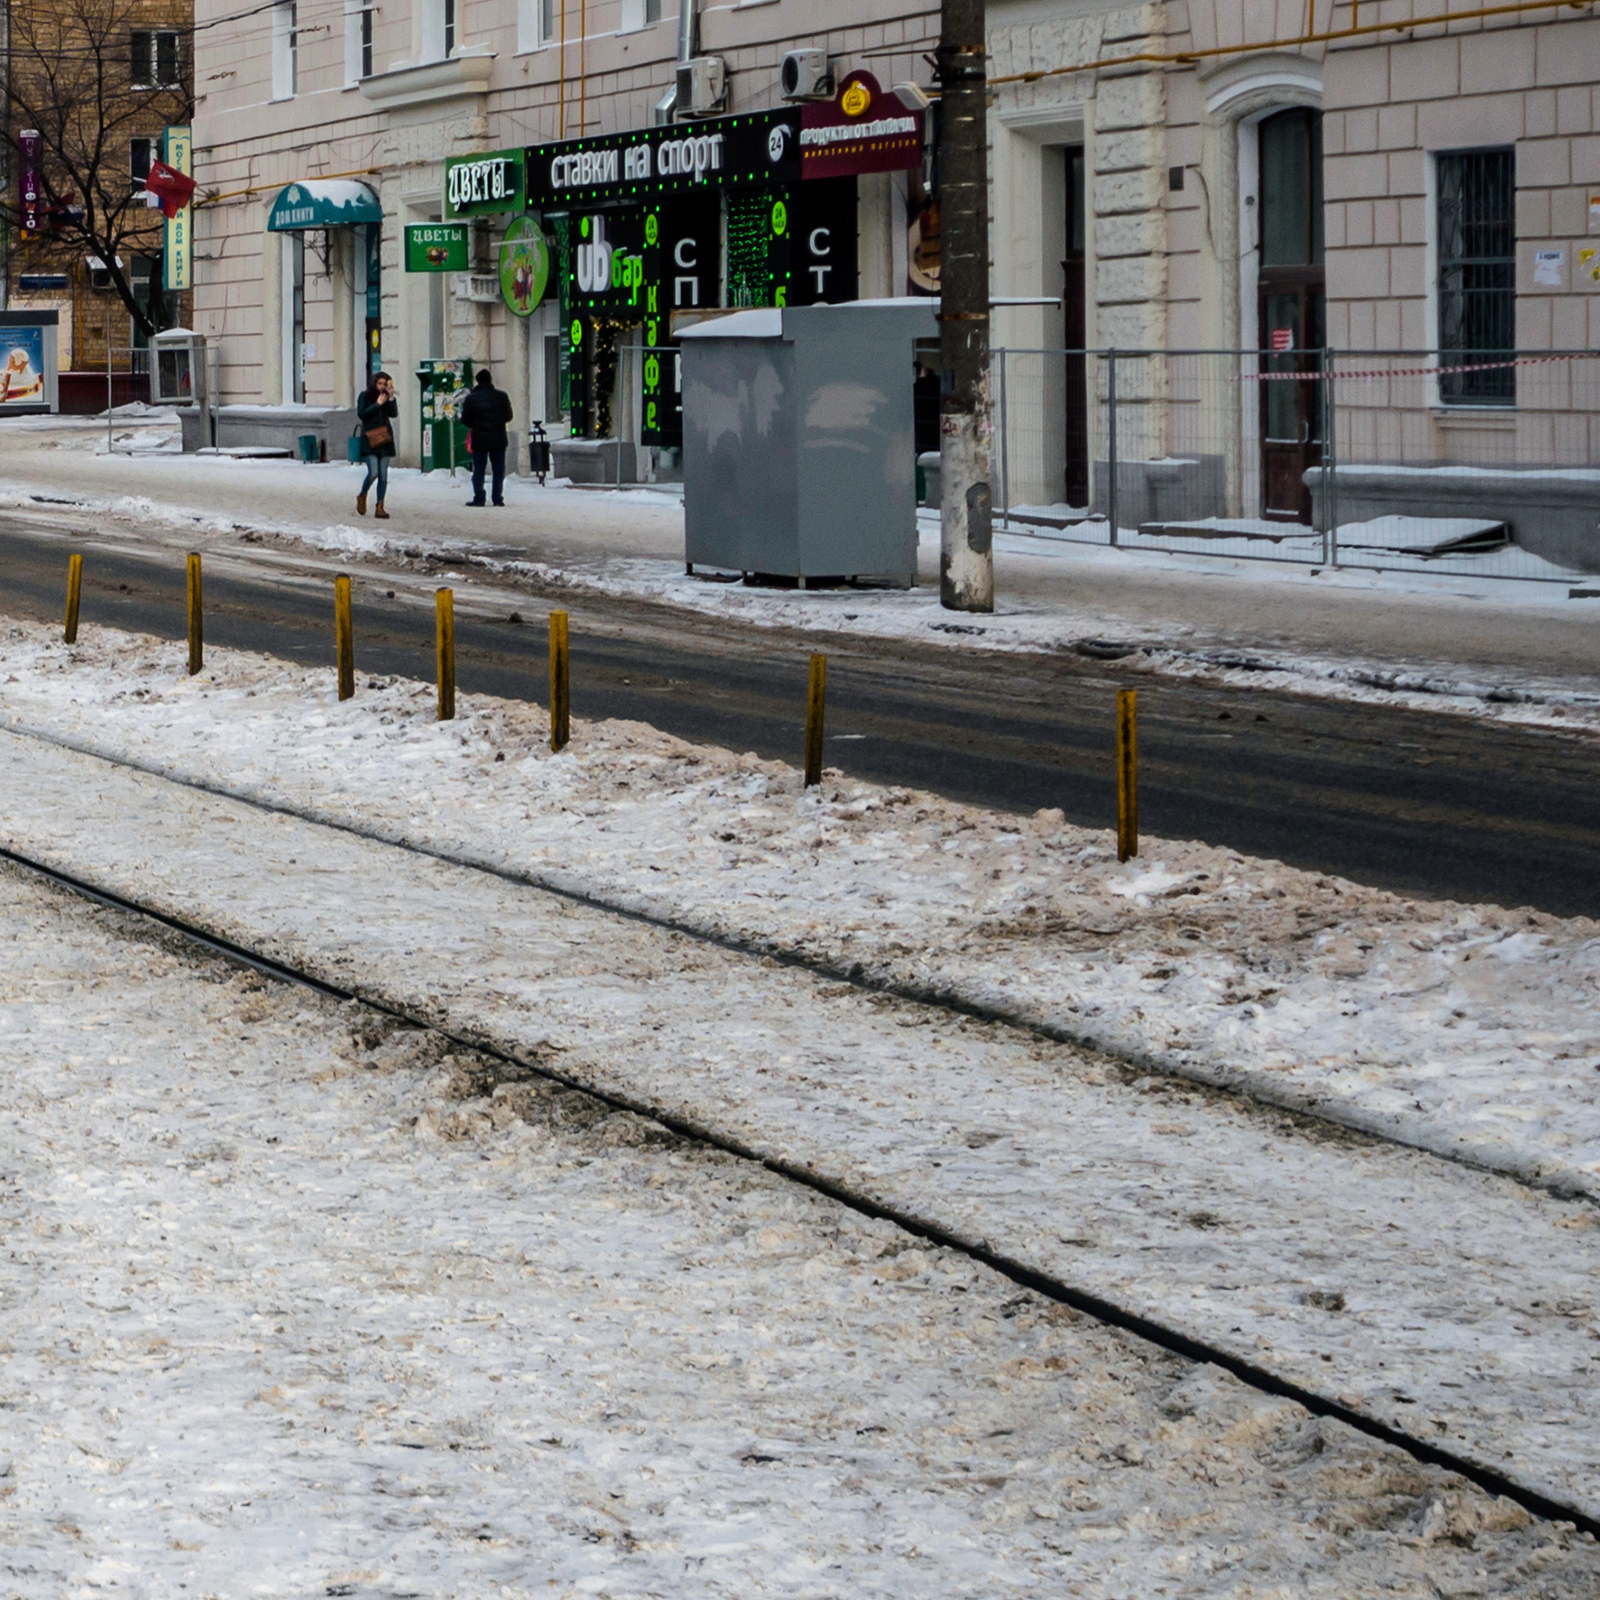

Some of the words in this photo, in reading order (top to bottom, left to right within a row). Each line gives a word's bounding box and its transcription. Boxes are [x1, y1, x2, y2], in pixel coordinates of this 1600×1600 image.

[770, 136, 783, 151] 24
[448, 158, 508, 212] ЦВЕТЫ
[413, 228, 462, 245] ЦВЕТЫ
